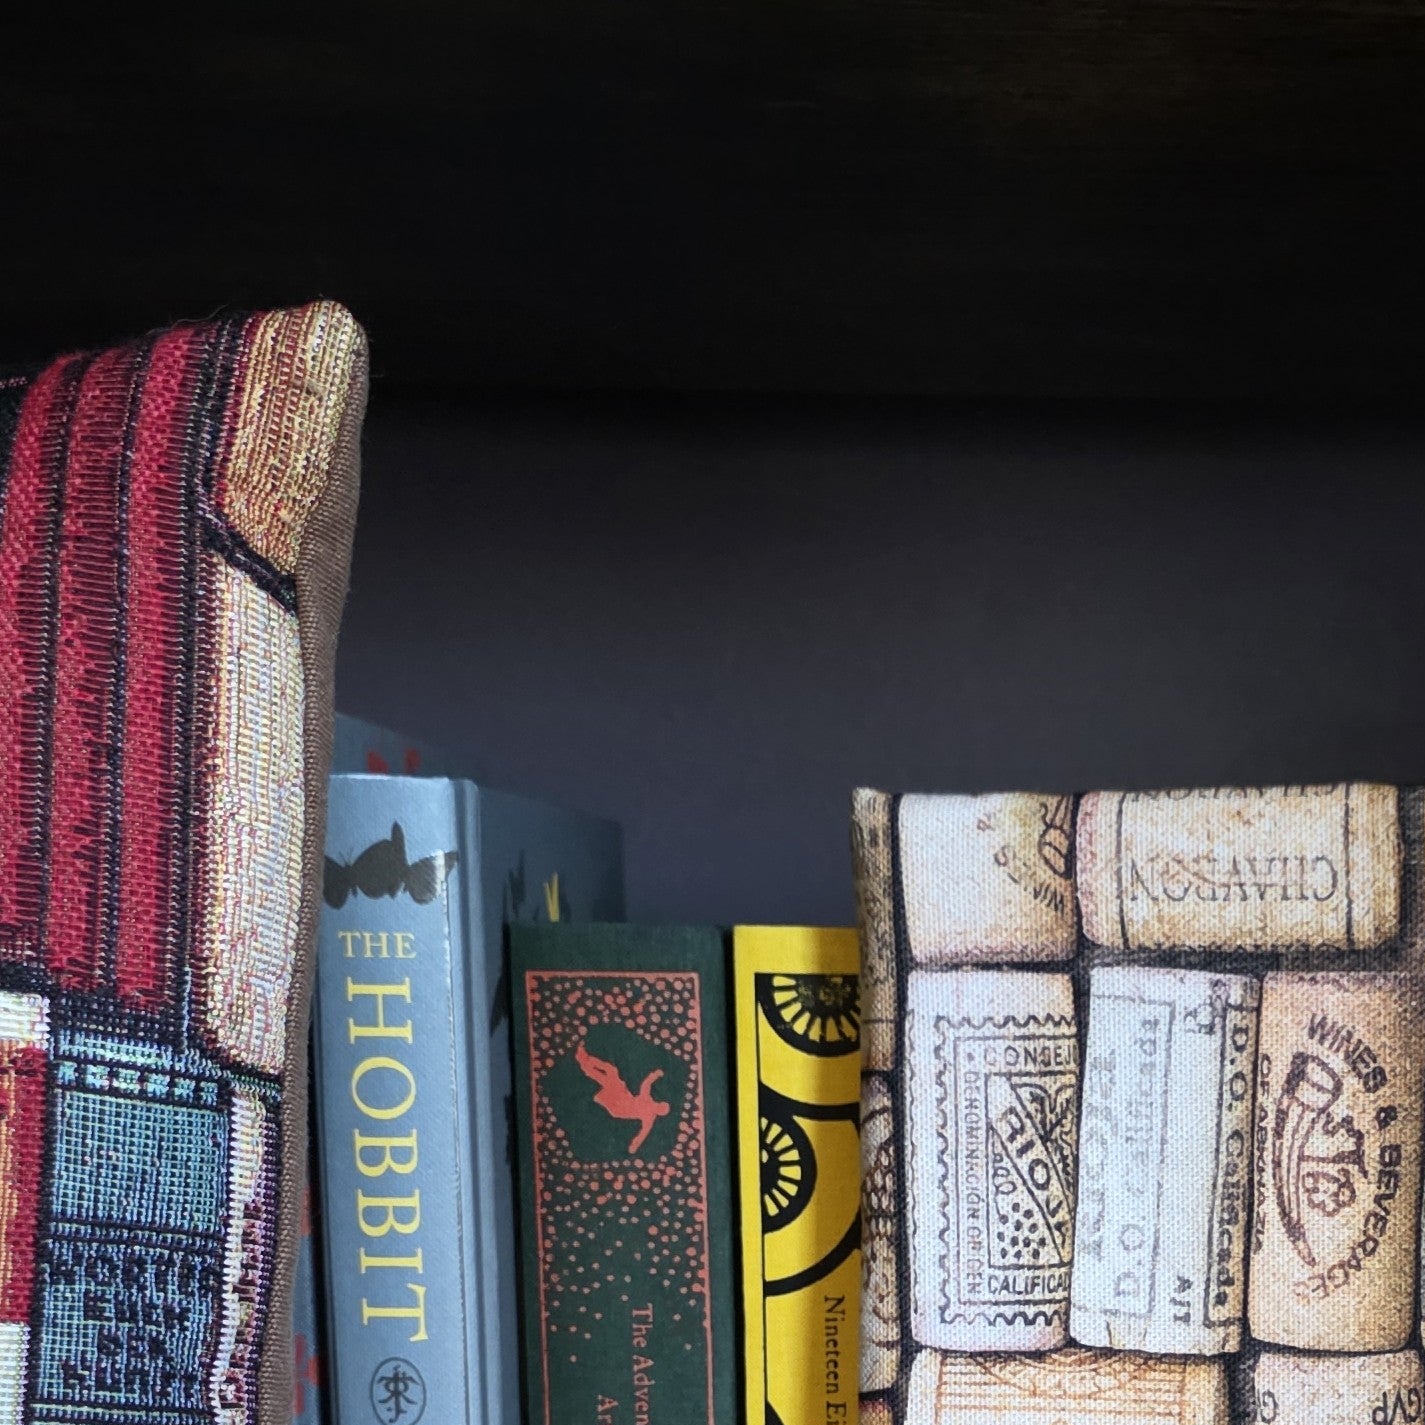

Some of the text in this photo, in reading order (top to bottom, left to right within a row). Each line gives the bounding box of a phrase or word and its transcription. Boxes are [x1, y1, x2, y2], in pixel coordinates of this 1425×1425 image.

[338, 930, 418, 959] THE
[1305, 1011, 1389, 1095] WINES
[1374, 1104, 1399, 1131] &
[345, 976, 430, 1342] HOBBIT
[632, 1303, 653, 1348] The
[824, 1295, 846, 1394] Nineteen
